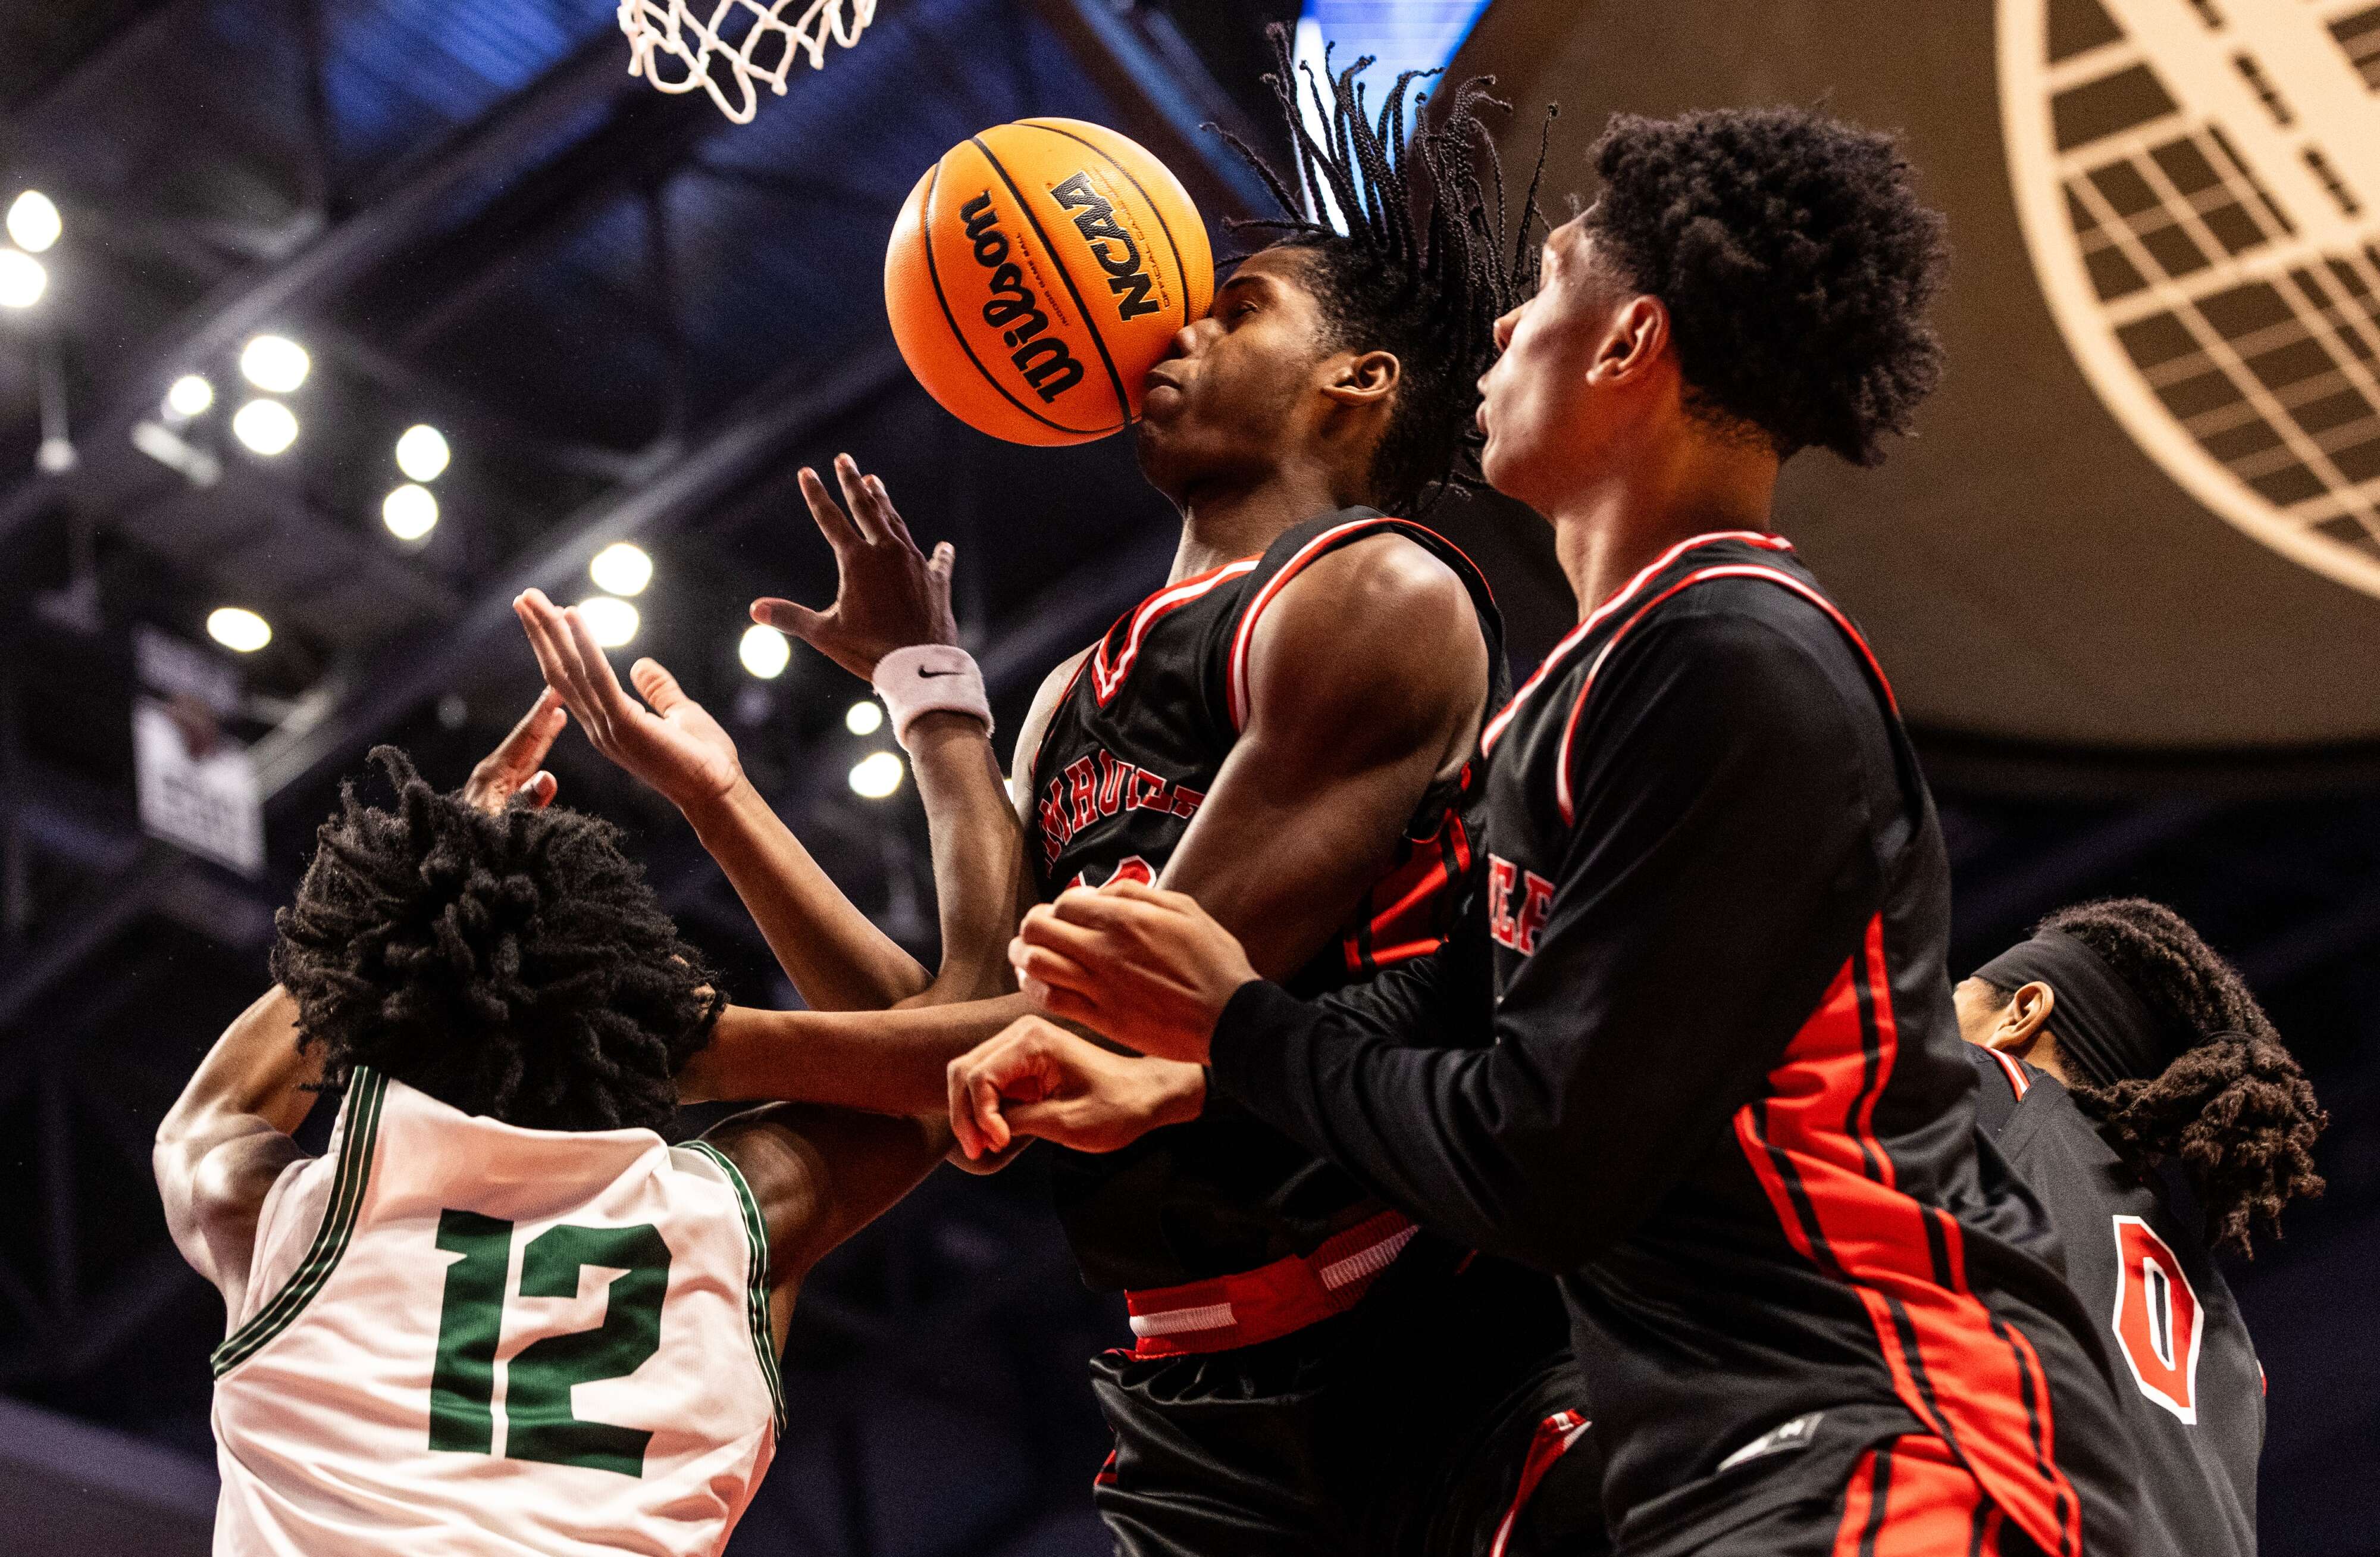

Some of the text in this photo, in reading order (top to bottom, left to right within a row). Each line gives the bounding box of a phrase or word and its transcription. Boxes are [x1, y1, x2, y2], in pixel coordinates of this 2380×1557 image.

[959, 189, 1084, 404] Wilson
[1016, 233, 1069, 326] INDOOR GAME BALL
[1050, 171, 1160, 321] NCAA
[1145, 243, 1170, 308] OFFICIAL
[428, 1208, 672, 1479] 12
[2112, 1214, 2204, 1425] 0
